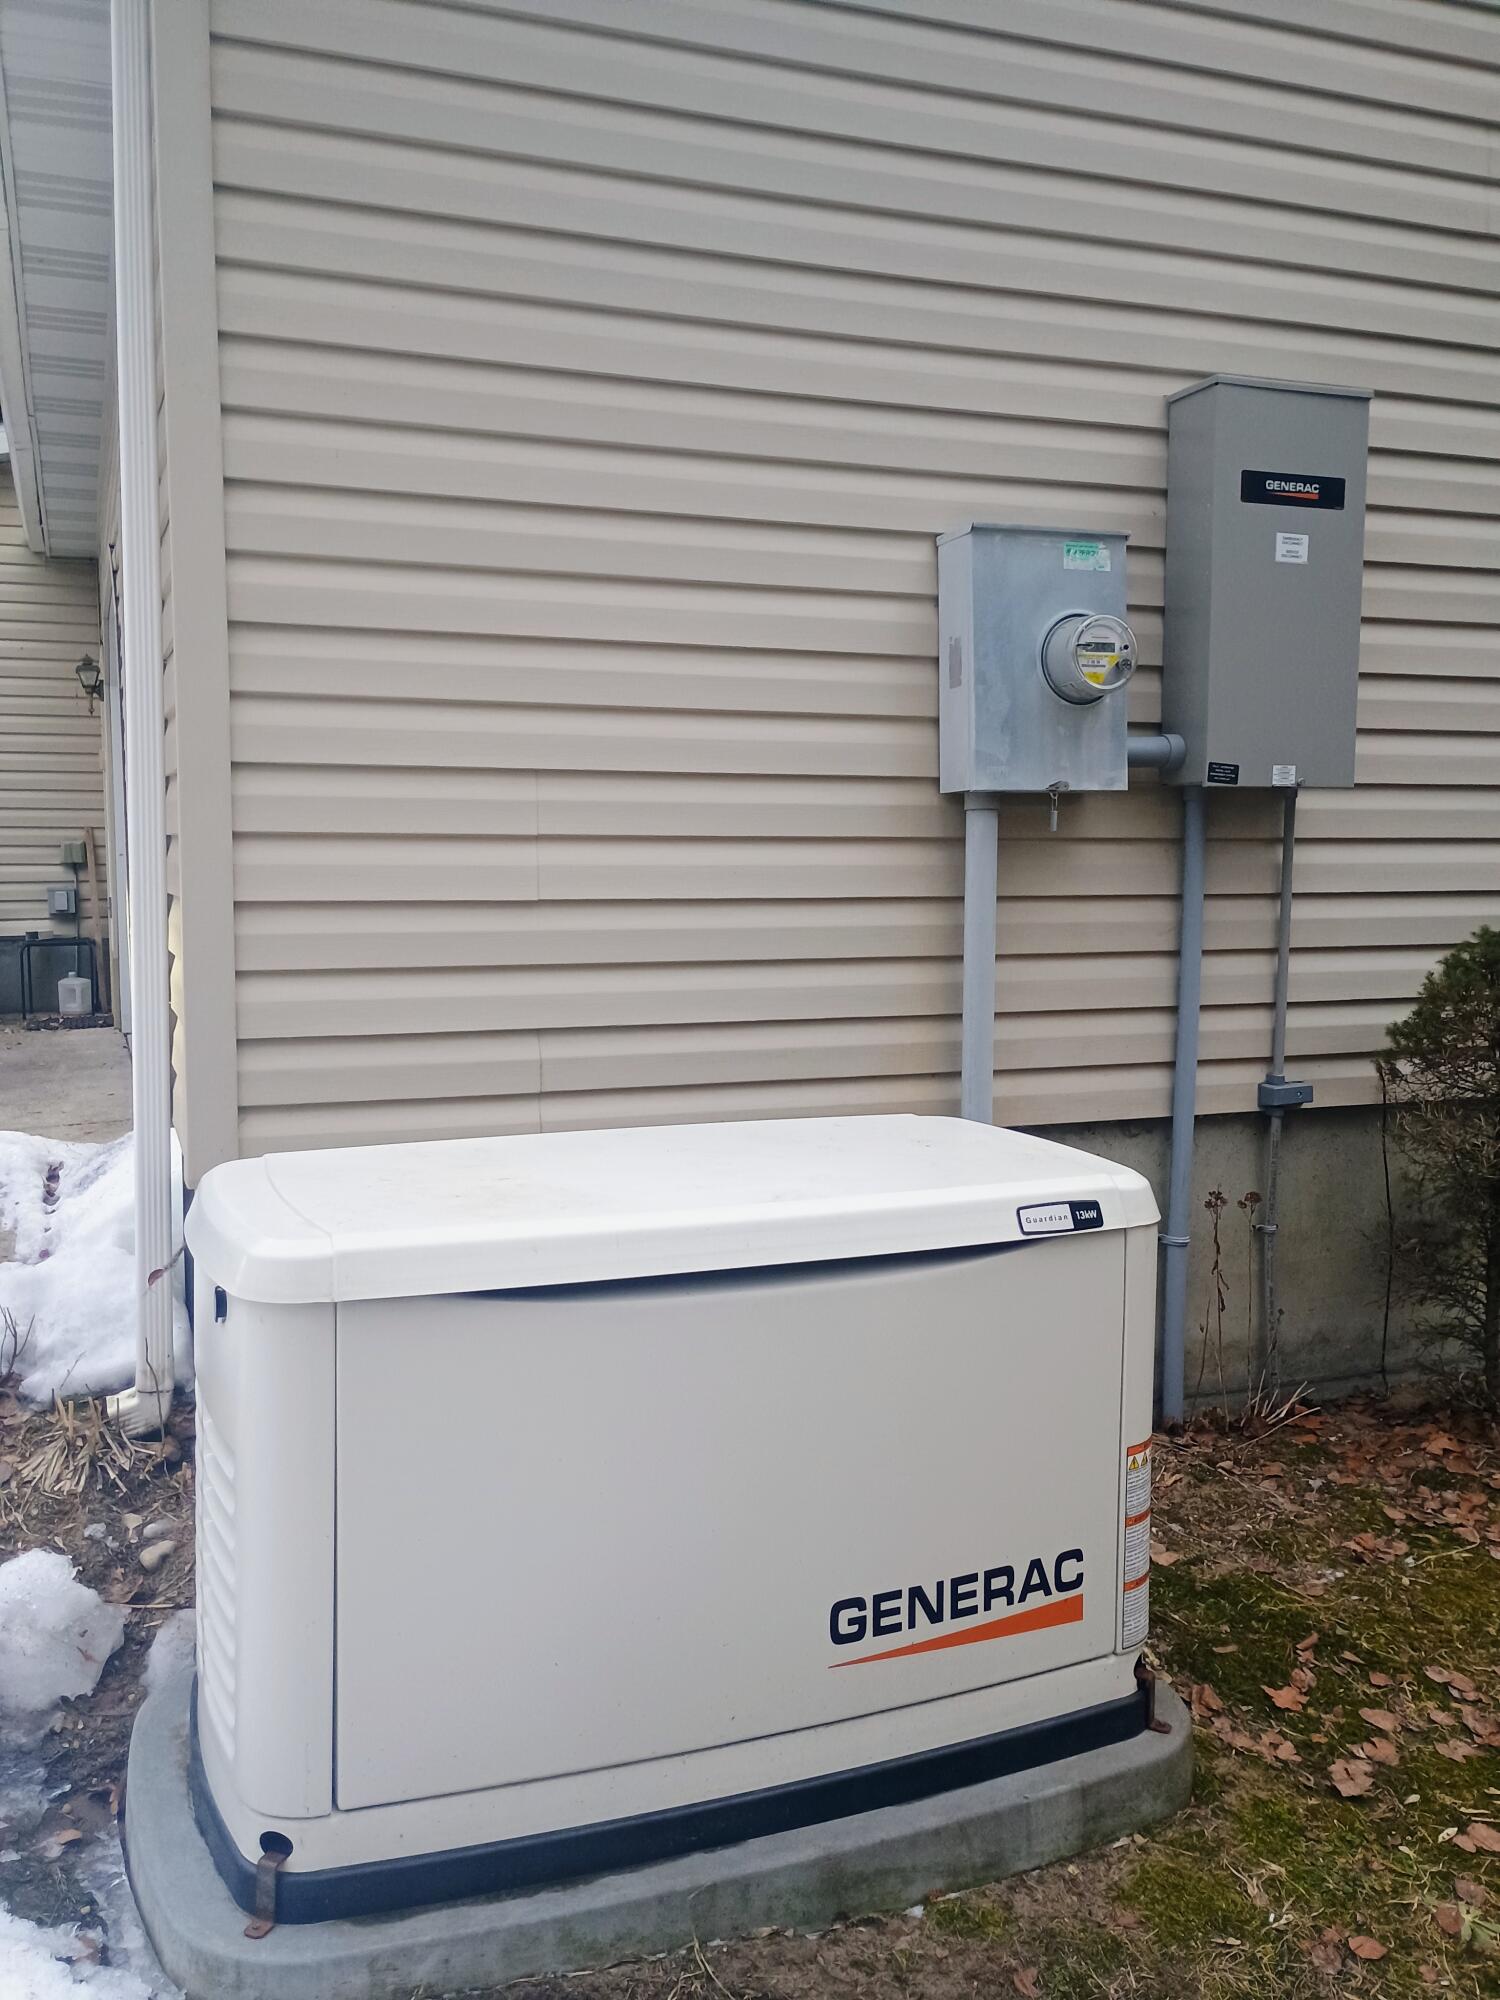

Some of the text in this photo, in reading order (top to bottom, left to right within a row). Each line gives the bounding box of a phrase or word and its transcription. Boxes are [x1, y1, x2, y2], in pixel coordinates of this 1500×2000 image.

[1265, 480, 1320, 493] GENERAC
[1025, 1209, 1098, 1224] Guardian 13kW
[829, 1548, 1084, 1646] GENERAC
